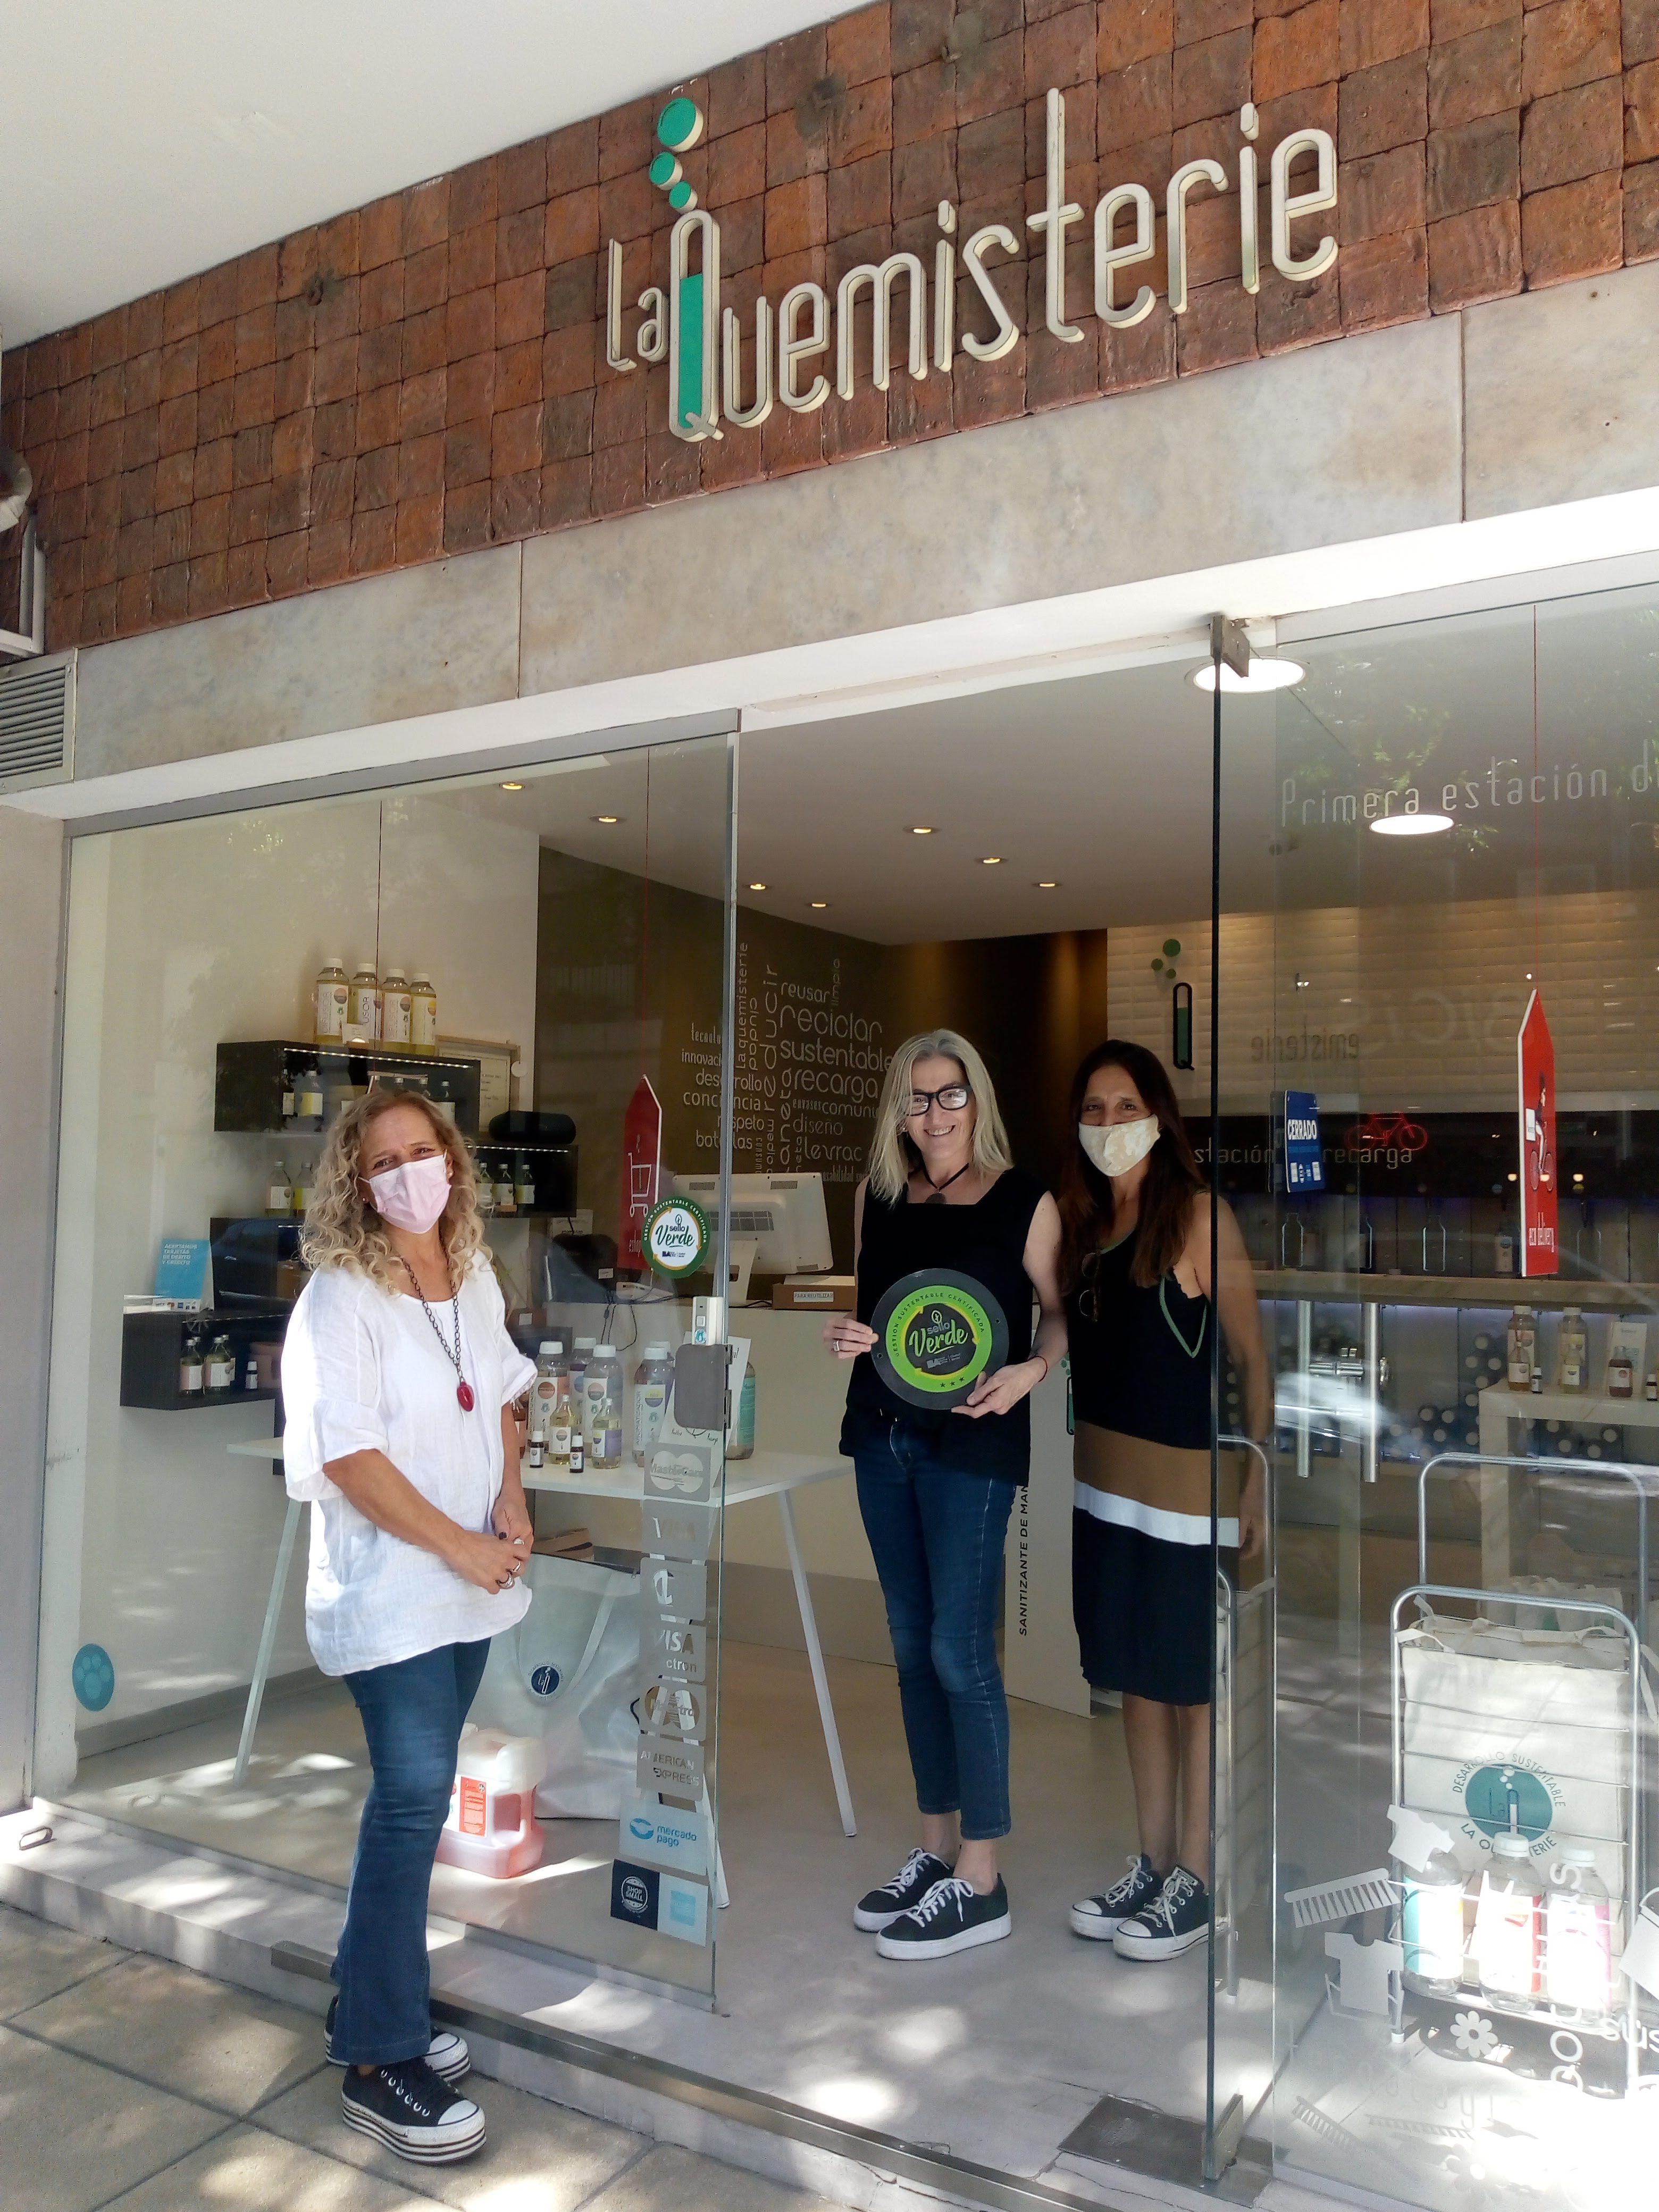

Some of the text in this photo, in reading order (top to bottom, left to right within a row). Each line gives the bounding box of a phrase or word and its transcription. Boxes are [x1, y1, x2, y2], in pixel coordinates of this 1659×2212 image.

[1281, 738, 1659, 827] Primera estación d
[781, 982, 830, 1003] reusar
[749, 997, 759, 1070] ciudad
[780, 1005, 883, 1042] reciclar
[759, 964, 778, 1111] reducir
[780, 1037, 893, 1072] sustentable
[696, 1069, 762, 1091] desrollo
[794, 1069, 878, 1103] recarga
[717, 1114, 764, 1133] rspeto
[780, 1068, 791, 1172] aneta
[822, 1102, 878, 1118] comuni
[793, 1113, 843, 1136] diseño
[1287, 1119, 1317, 1141] CERRADO
[696, 1129, 753, 1150] botlas
[1194, 1137, 1412, 1169] stación recarga
[654, 1199, 689, 1213] SUSTENTABLE
[690, 1205, 707, 1243] CERTIFICADA
[656, 1225, 695, 1246] Verde
[898, 1292, 944, 1320] SUSTENTABLE
[948, 1294, 984, 1333] CERTIFICADA
[909, 1319, 968, 1358] Verde
[1020, 1518, 1028, 1538] DE
[1019, 1541, 1028, 1636] SANITIZANTE
[657, 1825, 697, 1841] mercado
[657, 1834, 679, 1847] pago
[1461, 1823, 1476, 1839] LA
